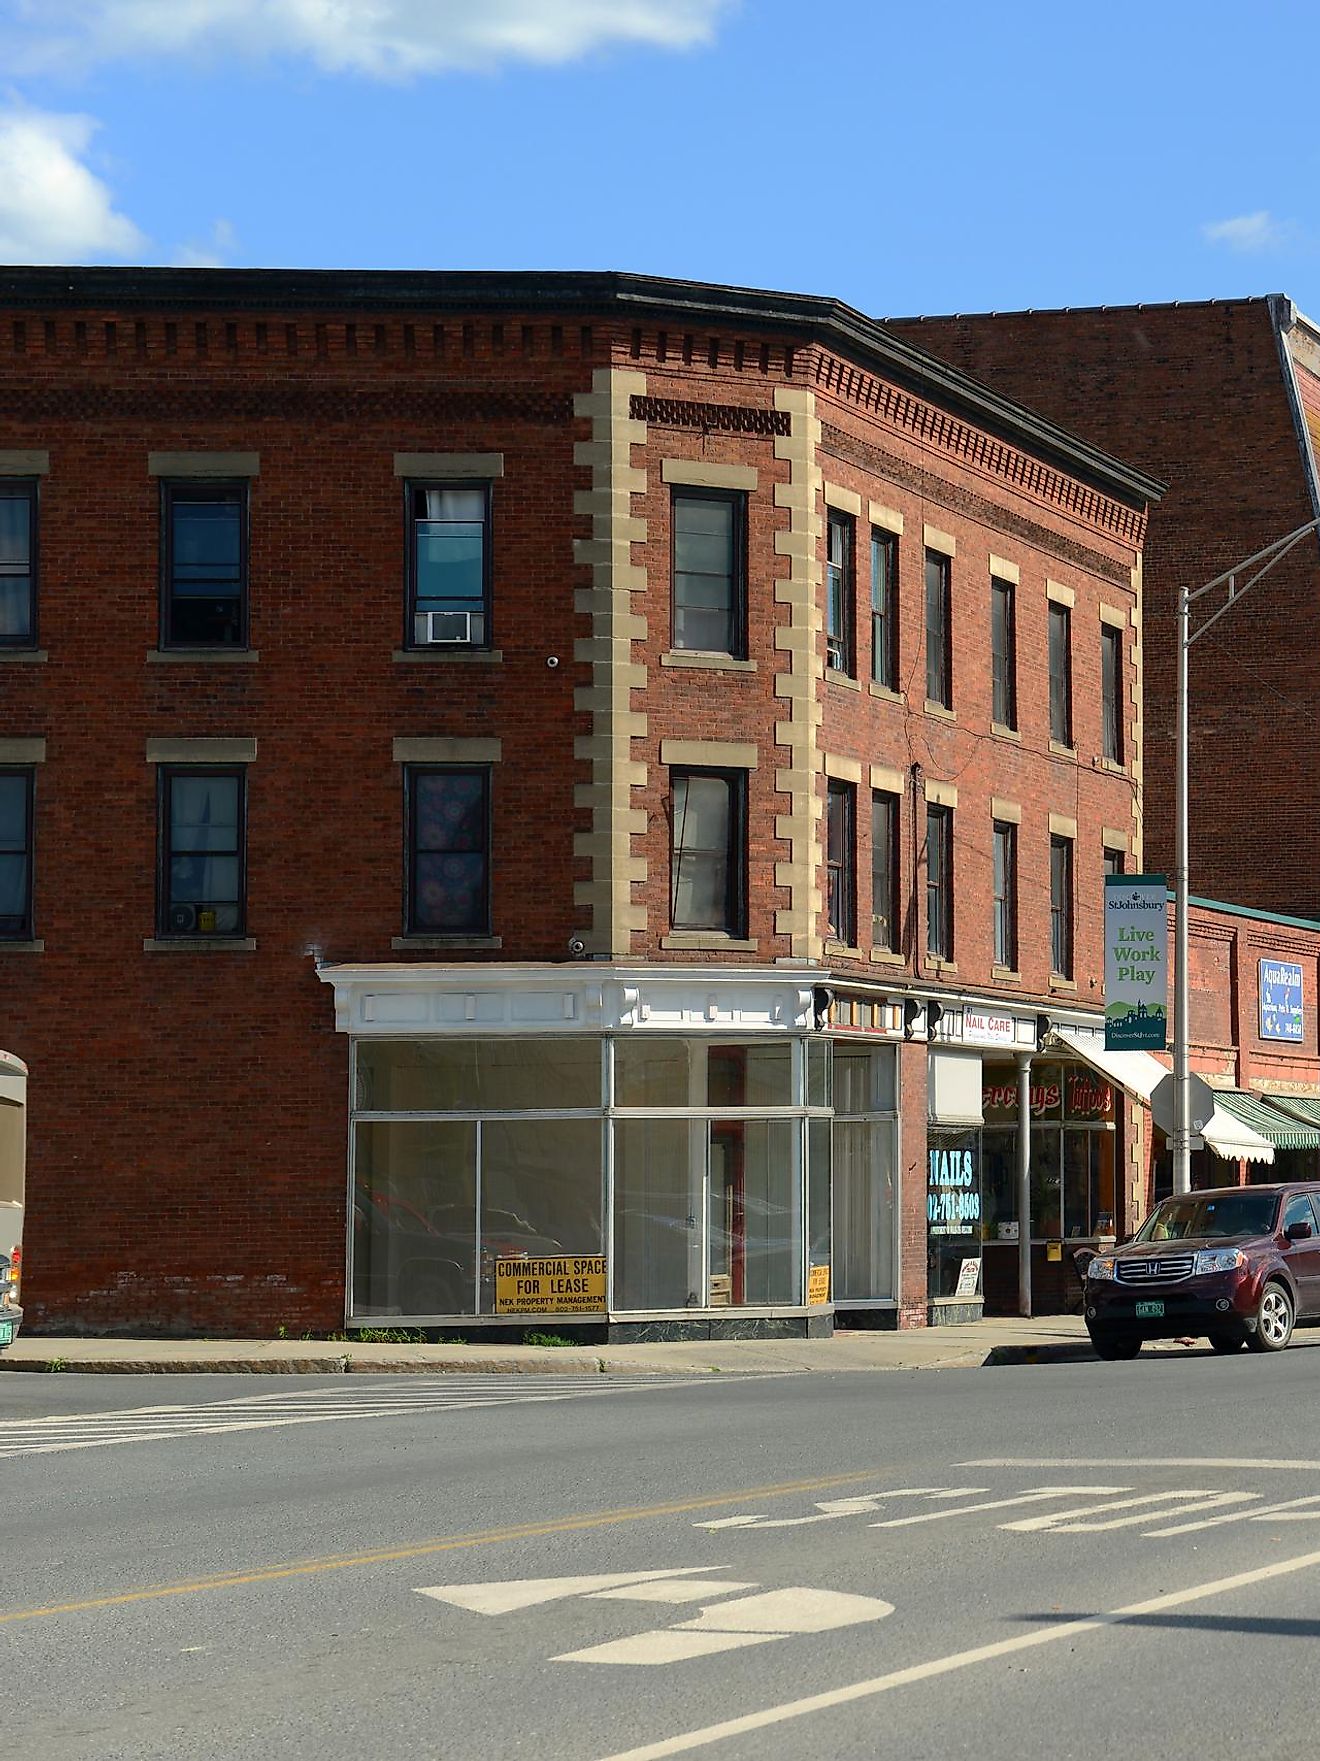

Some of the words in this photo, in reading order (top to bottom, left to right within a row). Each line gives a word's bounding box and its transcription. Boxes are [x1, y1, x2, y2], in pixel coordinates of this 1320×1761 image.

[1118, 926, 1154, 941] Live
[1112, 945, 1161, 961] Work
[1117, 966, 1155, 985] Play
[1264, 965, 1301, 990] AquaRealm
[966, 1014, 985, 1030] NAIL
[988, 1016, 1011, 1033] CARE
[982, 1083, 1060, 1116] ercgs
[929, 1150, 973, 1187] NAILS
[498, 1261, 569, 1277] COMMERCIAL
[574, 1259, 607, 1275] SPACE
[517, 1279, 540, 1294] FOR
[551, 1278, 589, 1293] LEASE
[517, 1297, 554, 1305] PROPERTY
[556, 1295, 606, 1304] MANAGEMENT
